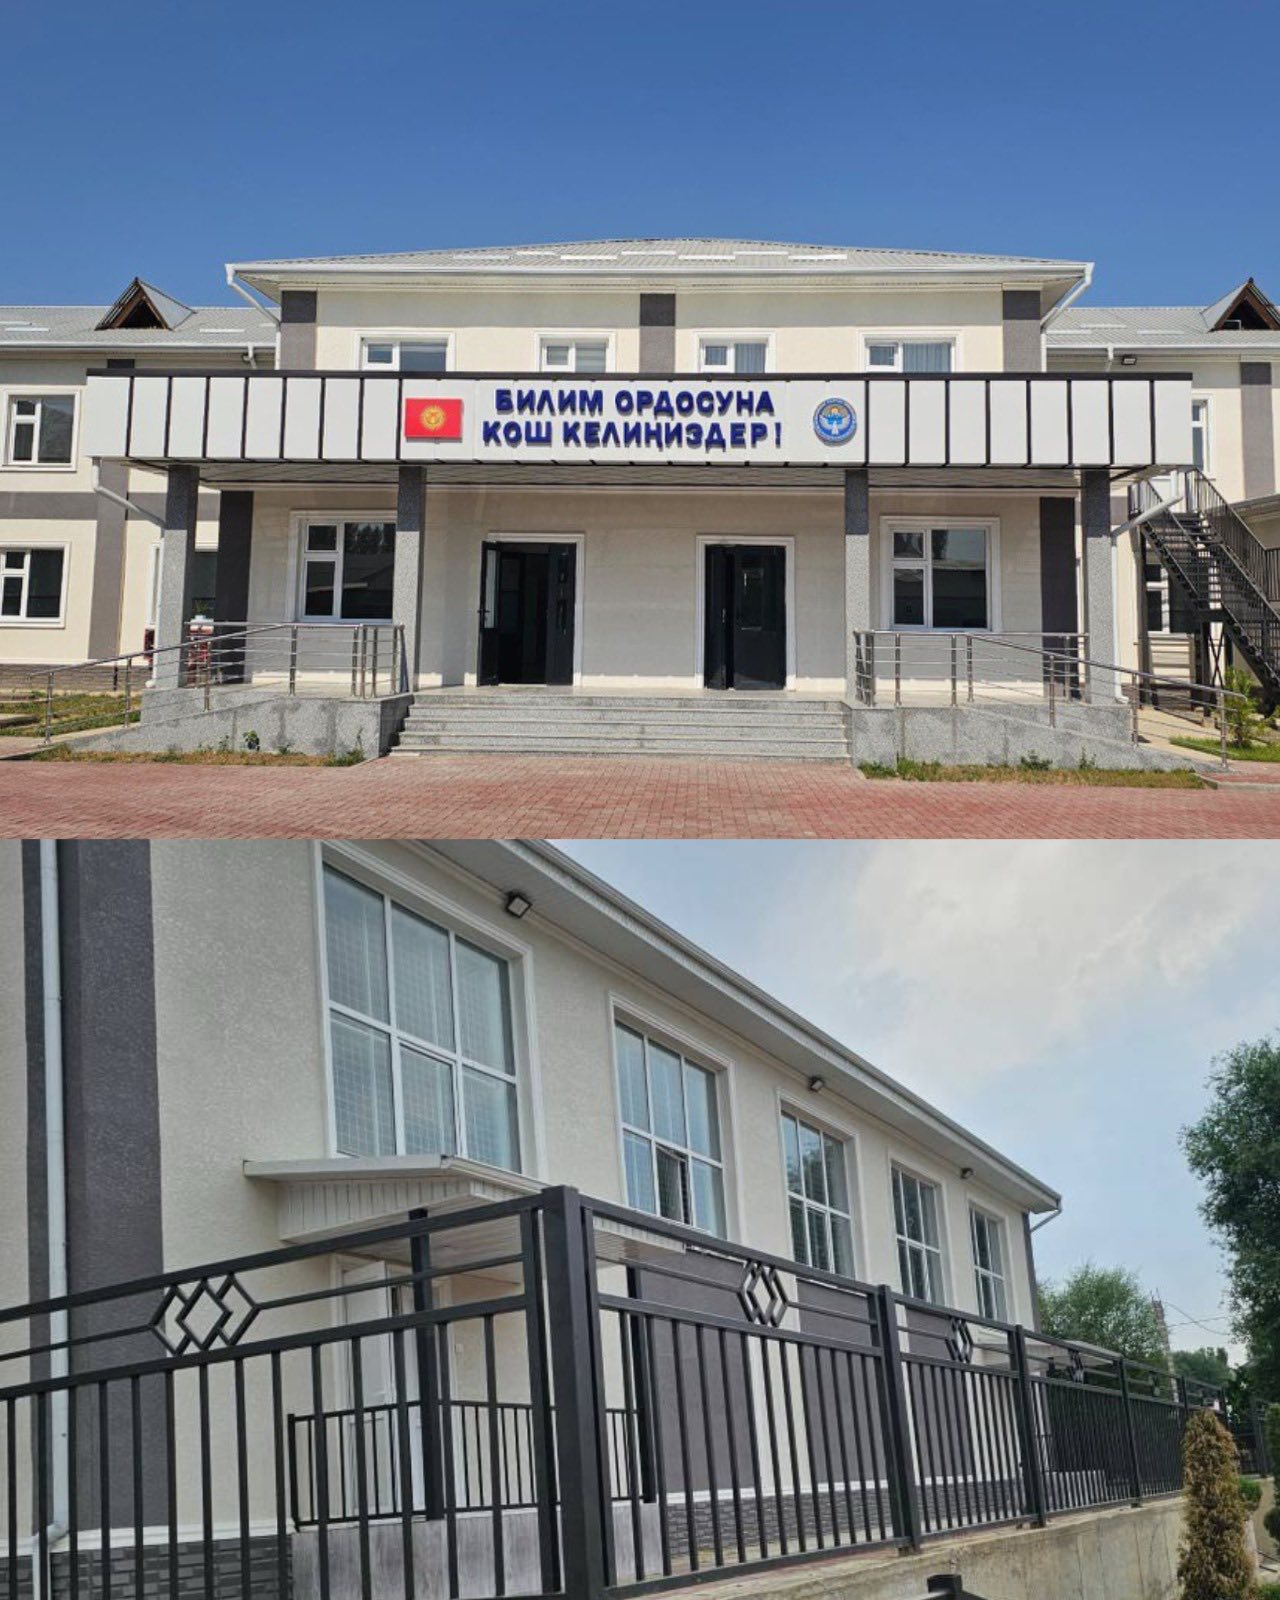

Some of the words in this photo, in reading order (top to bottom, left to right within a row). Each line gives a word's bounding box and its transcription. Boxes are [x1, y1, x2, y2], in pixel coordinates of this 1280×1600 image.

[495, 389, 603, 414] БИЛИМ
[615, 390, 775, 418] ОРДОСУНА
[483, 420, 552, 446] КОШ
